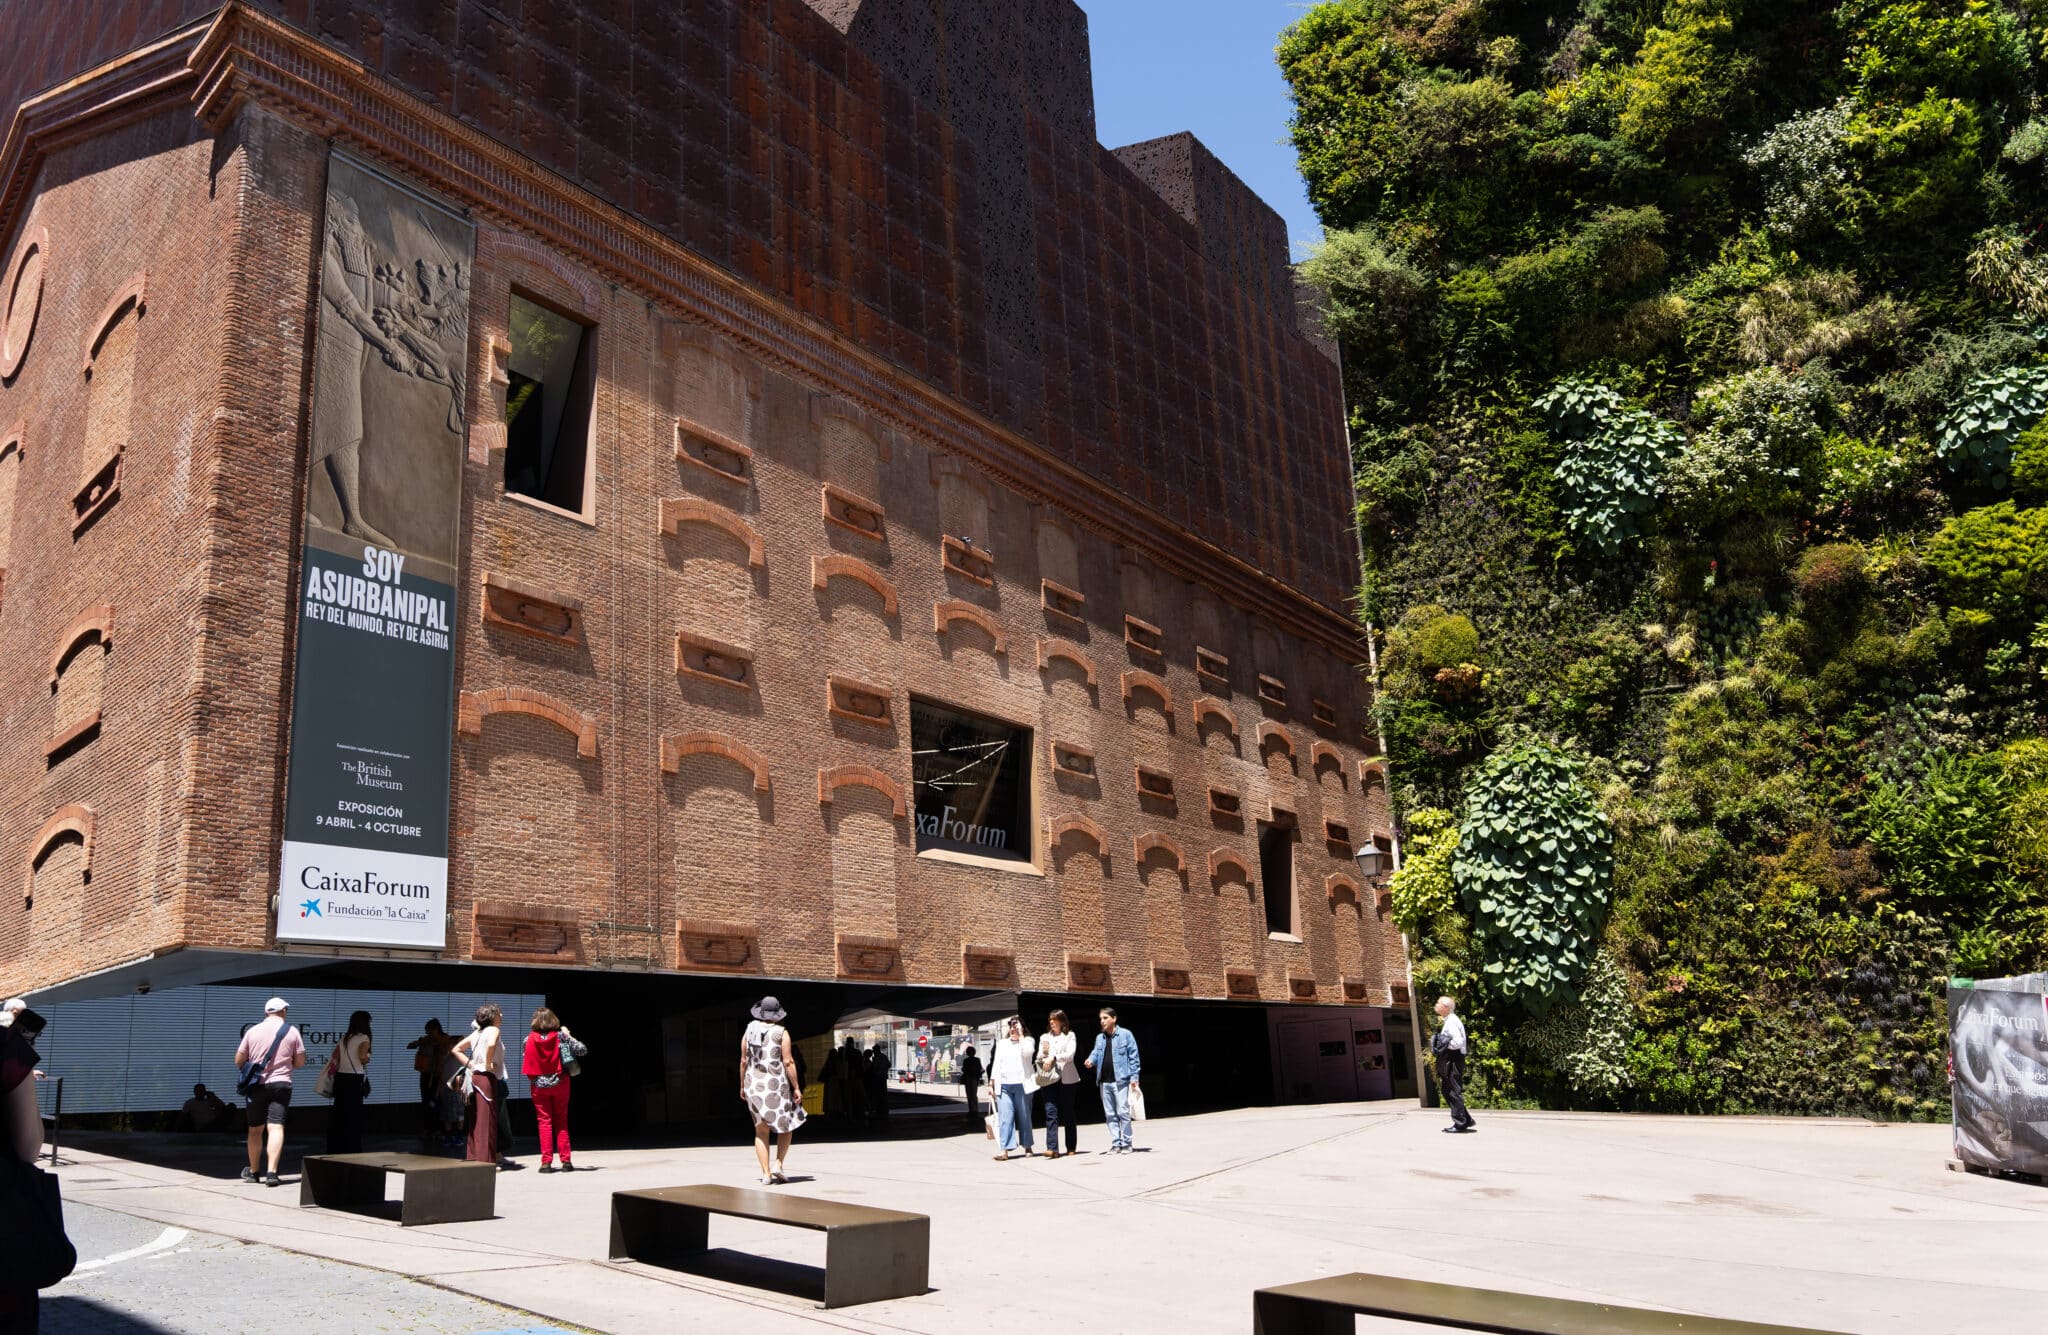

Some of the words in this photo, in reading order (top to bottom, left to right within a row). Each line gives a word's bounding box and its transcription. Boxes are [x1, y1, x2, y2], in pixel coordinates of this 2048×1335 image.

[363, 545, 405, 585] SOY
[307, 566, 449, 632] ASURBANIPAL
[306, 601, 327, 620] REY
[327, 606, 346, 626] DEL
[347, 611, 385, 636] MUNDO,
[386, 620, 405, 640] REY
[406, 625, 418, 642] DE
[419, 630, 449, 651] ASIRIA
[341, 761, 357, 773] The
[357, 760, 392, 777] British
[356, 773, 403, 790] Museum
[338, 800, 403, 818] EXPOSICIÓN
[316, 815, 323, 825] 9
[325, 816, 356, 829] ABRIL
[364, 821, 371, 831] 4
[373, 822, 422, 837] OCTUBRE
[915, 805, 1007, 849] xaForum
[301, 866, 430, 899] CaixaForum
[327, 901, 382, 917] Fundación
[384, 906, 396, 918] "la
[398, 908, 430, 920] Caixa"
[1958, 1004, 2038, 1030] CaixaForum
